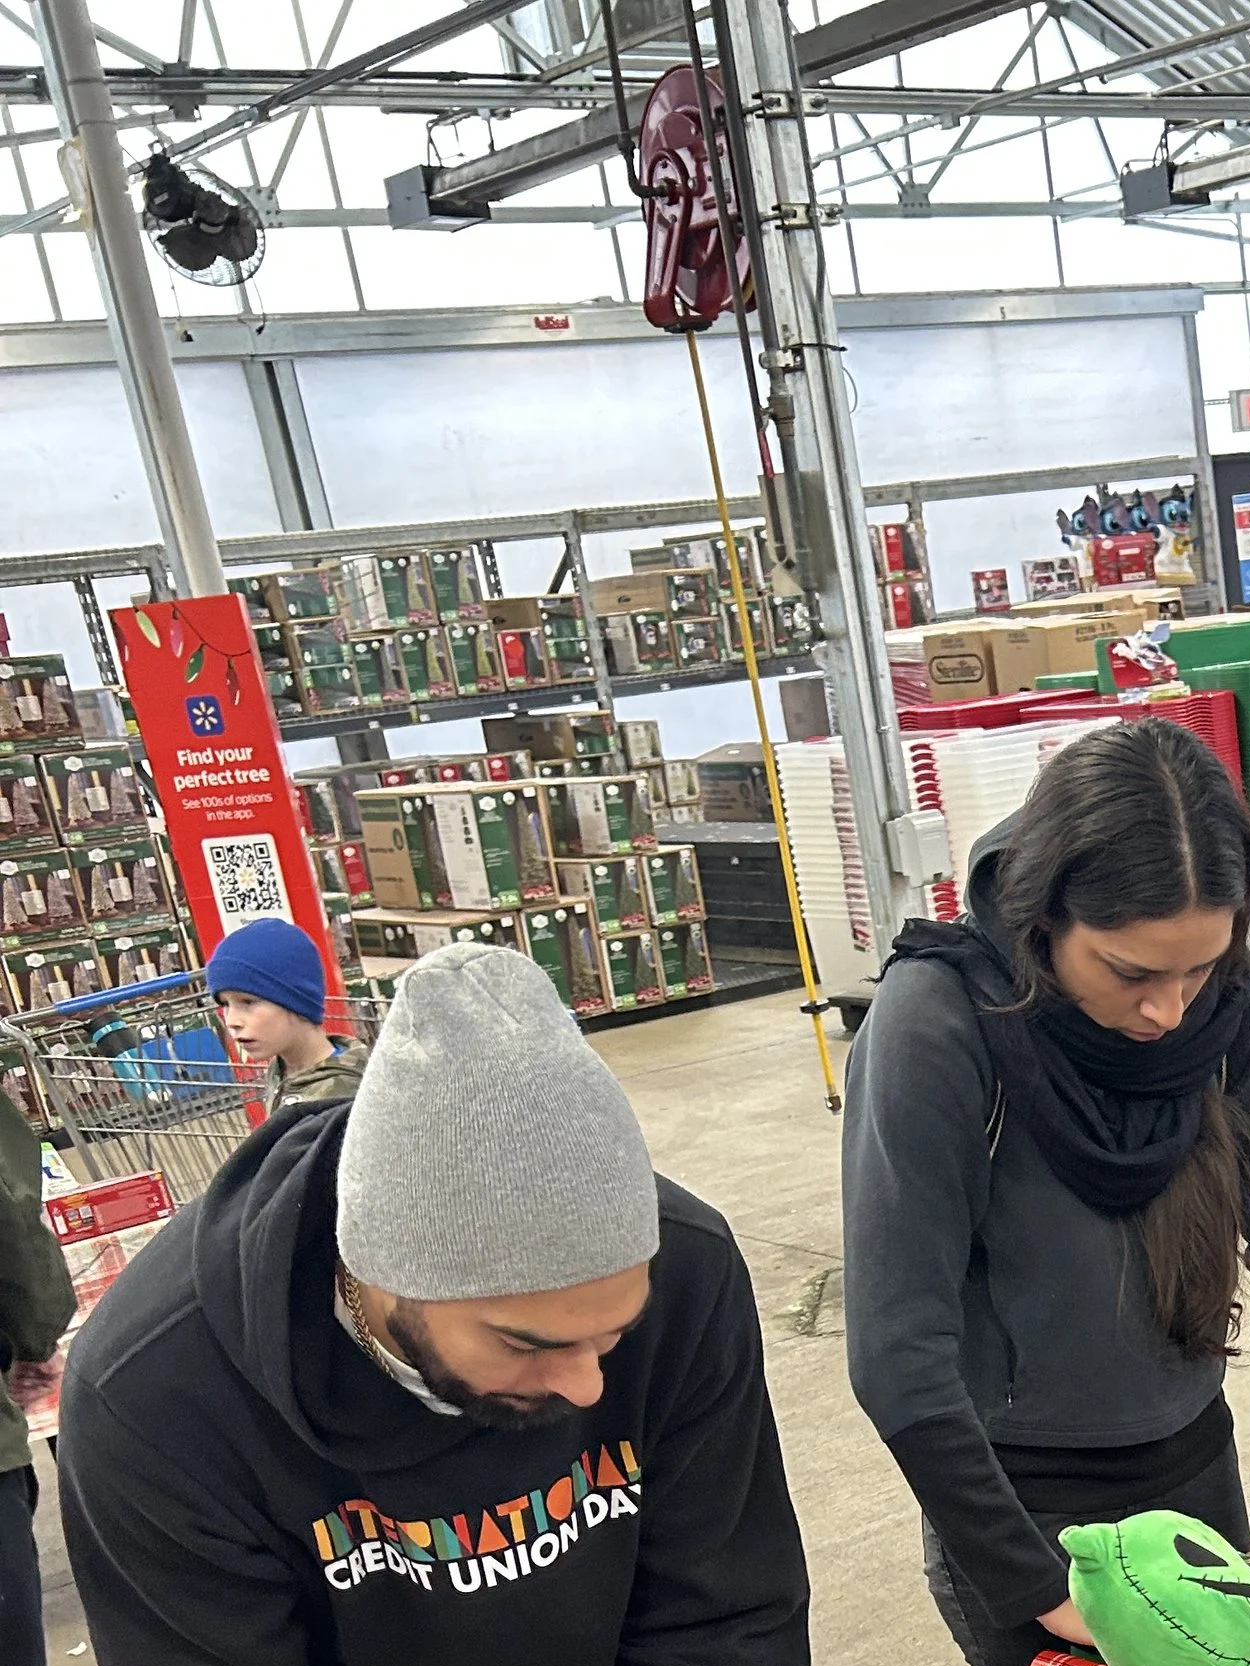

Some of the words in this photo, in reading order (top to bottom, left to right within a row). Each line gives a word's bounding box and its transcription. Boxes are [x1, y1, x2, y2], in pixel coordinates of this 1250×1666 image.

[177, 747, 214, 766] Find
[214, 747, 253, 766] your
[174, 770, 234, 792] perfect
[234, 768, 270, 784] tree
[182, 799, 201, 810] See
[200, 796, 224, 808] 100s
[224, 794, 234, 806] of
[235, 793, 273, 806] options
[206, 811, 216, 821] in
[216, 810, 232, 820] the
[233, 809, 255, 820] app.
[324, 1541, 434, 1591] CREDIT
[449, 1510, 579, 1593] UNION
